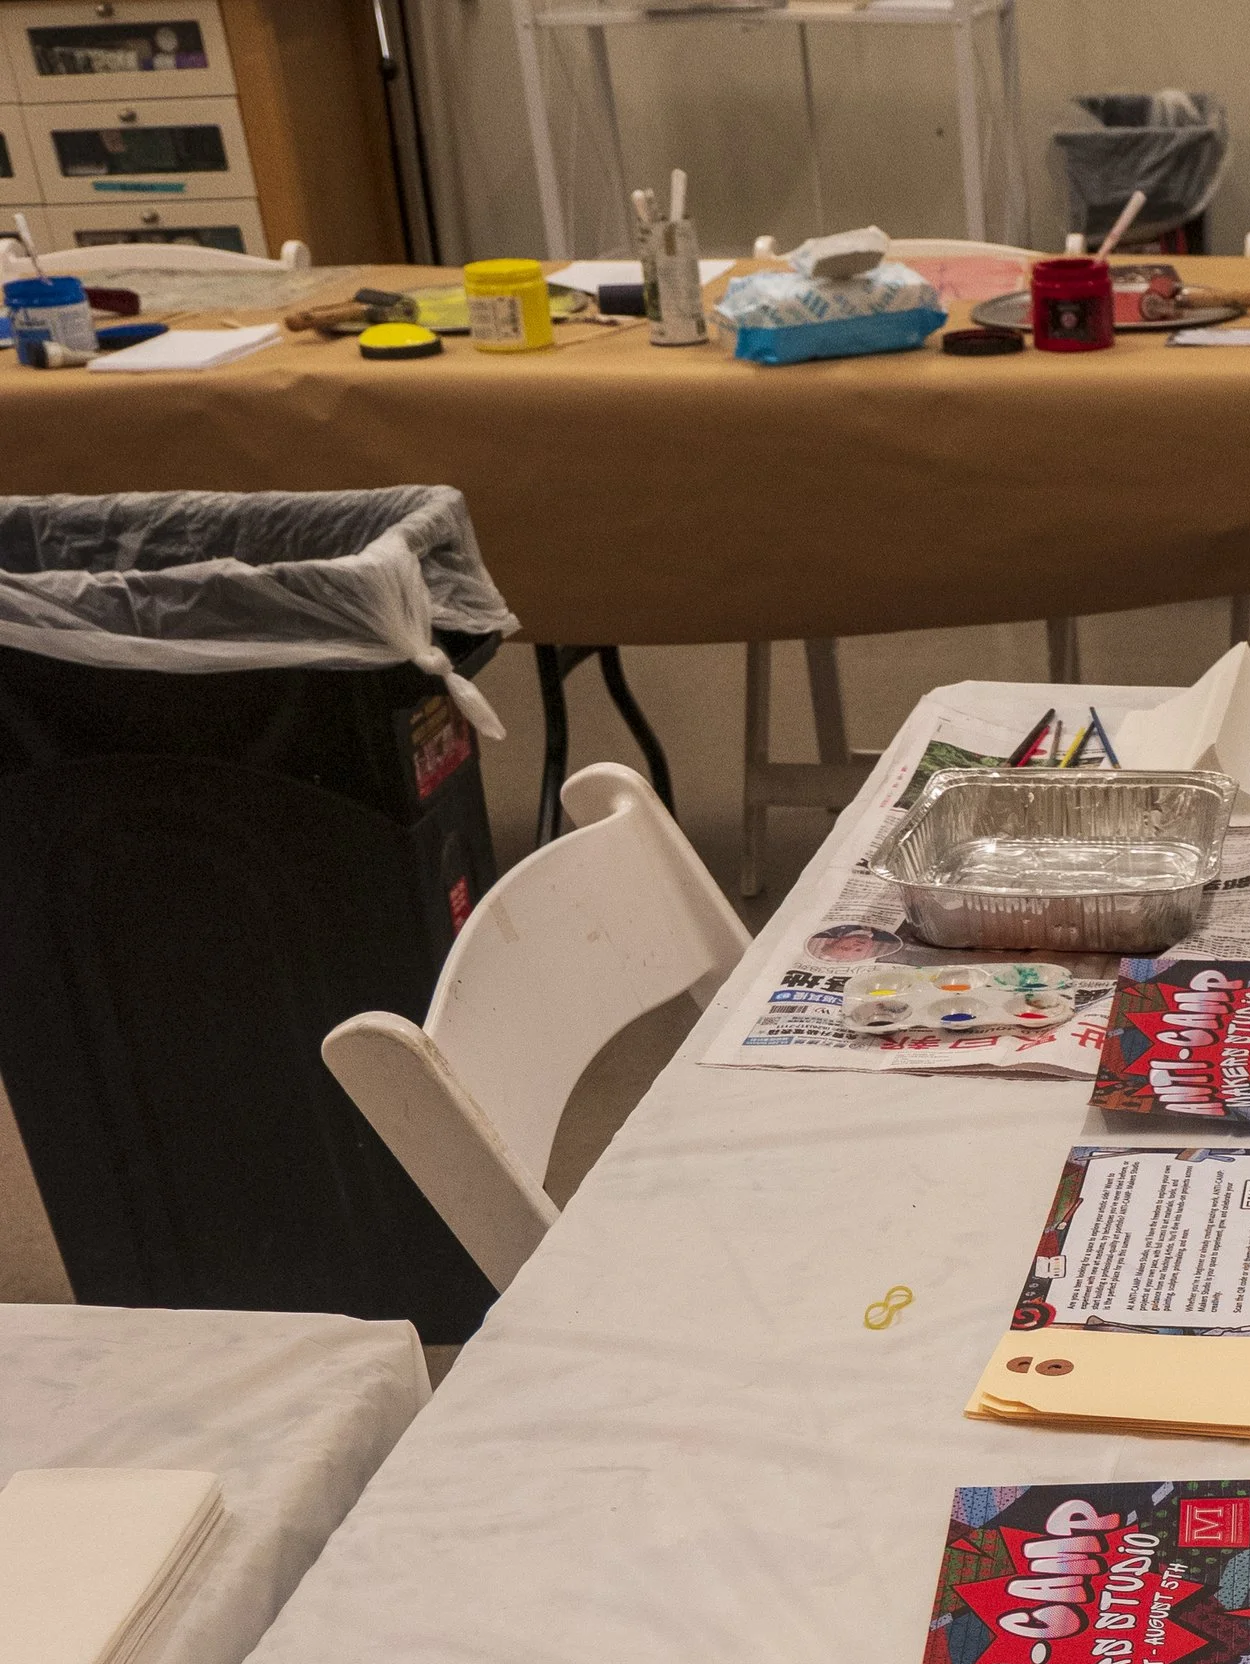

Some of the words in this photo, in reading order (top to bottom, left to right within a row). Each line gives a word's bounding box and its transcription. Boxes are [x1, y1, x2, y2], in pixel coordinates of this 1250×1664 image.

[1150, 970, 1243, 1116] ANTI-CAMP
[1129, 1161, 1141, 1175] Studio
[1163, 1164, 1172, 1174] own
[1184, 1165, 1194, 1178] across
[1103, 1177, 1115, 1190] Want
[1114, 1180, 1125, 1190] tried
[1125, 1174, 1137, 1190] Makers
[1161, 1174, 1171, 1184] your
[1169, 1179, 1180, 1187] and
[1156, 1184, 1169, 1199] explore
[1179, 1178, 1193, 1195] projects
[1225, 1182, 1236, 1192] your
[1100, 1189, 1111, 1200] side?
[1113, 1190, 1122, 1202] never
[1096, 1200, 1108, 1214] artistic
[1175, 1194, 1187, 1214] hands-on
[1220, 1192, 1232, 1211] celebrate
[1108, 1201, 1121, 1215] you've
[1150, 1204, 1163, 1221] freedom
[1218, 1210, 1229, 1218] and
[1095, 1213, 1106, 1223] your
[1173, 1213, 1183, 1222] into
[1207, 1208, 1219, 1224] amazing
[1089, 1222, 1103, 1237] explore
[1101, 1214, 1116, 1235] techniques
[1148, 1220, 1158, 1228] the
[1170, 1222, 1181, 1231] dive
[1146, 1227, 1157, 1237] have
[1157, 1229, 1167, 1242] access
[1167, 1230, 1178, 1242] You'll
[1202, 1224, 1215, 1240] creating
[1085, 1241, 1097, 1253] space
[1142, 1237, 1155, 1249] you'll
[1177, 1239, 1188, 1248] and
[1199, 1239, 1212, 1254] already
[1099, 1239, 1120, 1278] professional-quality
[1117, 1249, 1128, 1257] this
[1151, 1249, 1162, 1258] with
[1116, 1257, 1127, 1265] you
[1158, 1255, 1174, 1273] Teaching
[1193, 1258, 1208, 1276] beginner
[1208, 1256, 1219, 1268] space
[1241, 1262, 1250, 1271] visit
[1075, 1262, 1091, 1279] looking
[1090, 1266, 1099, 1275] new
[1134, 1262, 1147, 1277] Makers
[1147, 1268, 1156, 1278] own
[1206, 1267, 1217, 1278] your
[1085, 1275, 1096, 1286] with
[1109, 1271, 1123, 1282] place
[1145, 1277, 1156, 1288] your
[1158, 1273, 1167, 1281] our
[1237, 1276, 1248, 1287] code
[1073, 1278, 1084, 1289] teen
[1153, 1280, 1165, 1291] from
[1190, 1279, 1202, 1293] you're
[1200, 1281, 1212, 1296] Studio
[1092, 1281, 1109, 1299] building
[1105, 1282, 1119, 1298] perfect
[1070, 1292, 1082, 1301] you
[1079, 1285, 1095, 1310] experiment
[1103, 1297, 1113, 1306] the
[1137, 1292, 1152, 1312] projects
[1149, 1291, 1165, 1312] guidance
[1184, 1292, 1197, 1313] Whether
[1234, 1294, 1245, 1302] the
[1066, 1301, 1077, 1310] Are
[1090, 1299, 1101, 1311] start
[1196, 1295, 1209, 1313] Makers
[1232, 1302, 1243, 1314] Scan
[1144, 1593, 1174, 1645] AUGUST
[1161, 1563, 1189, 1590] 5TH
